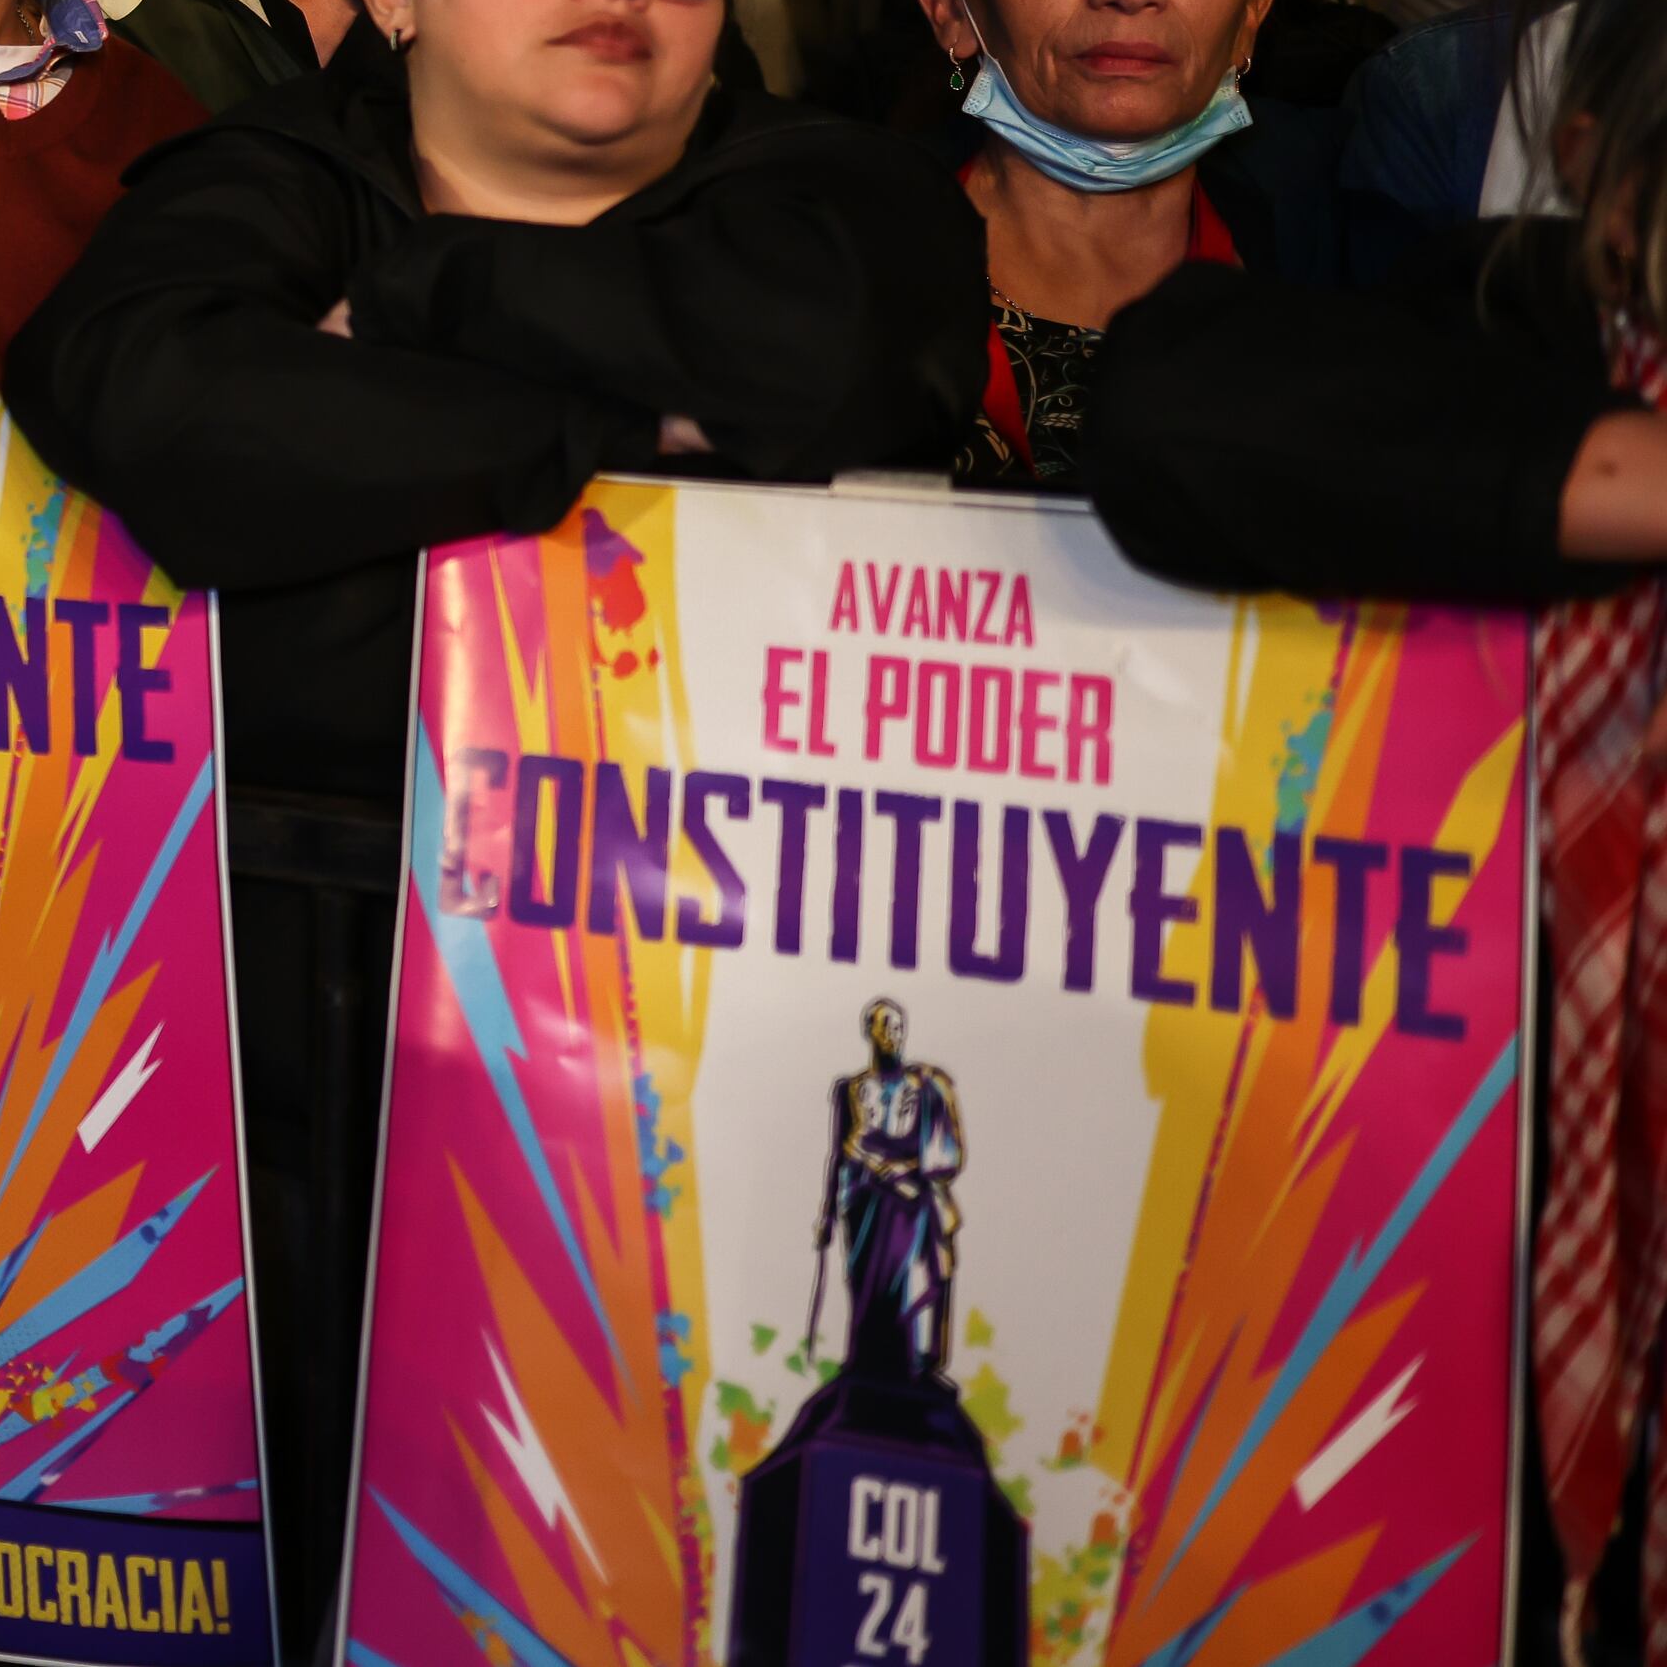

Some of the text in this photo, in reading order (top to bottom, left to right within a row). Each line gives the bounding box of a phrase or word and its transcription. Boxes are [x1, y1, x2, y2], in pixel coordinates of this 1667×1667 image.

[828, 558, 1036, 649] AVANZA
[760, 645, 1116, 788] EL PODER
[438, 745, 1474, 1044] CONSTITUYENTE
[847, 1474, 948, 1575] COL
[854, 1572, 932, 1666] 24
